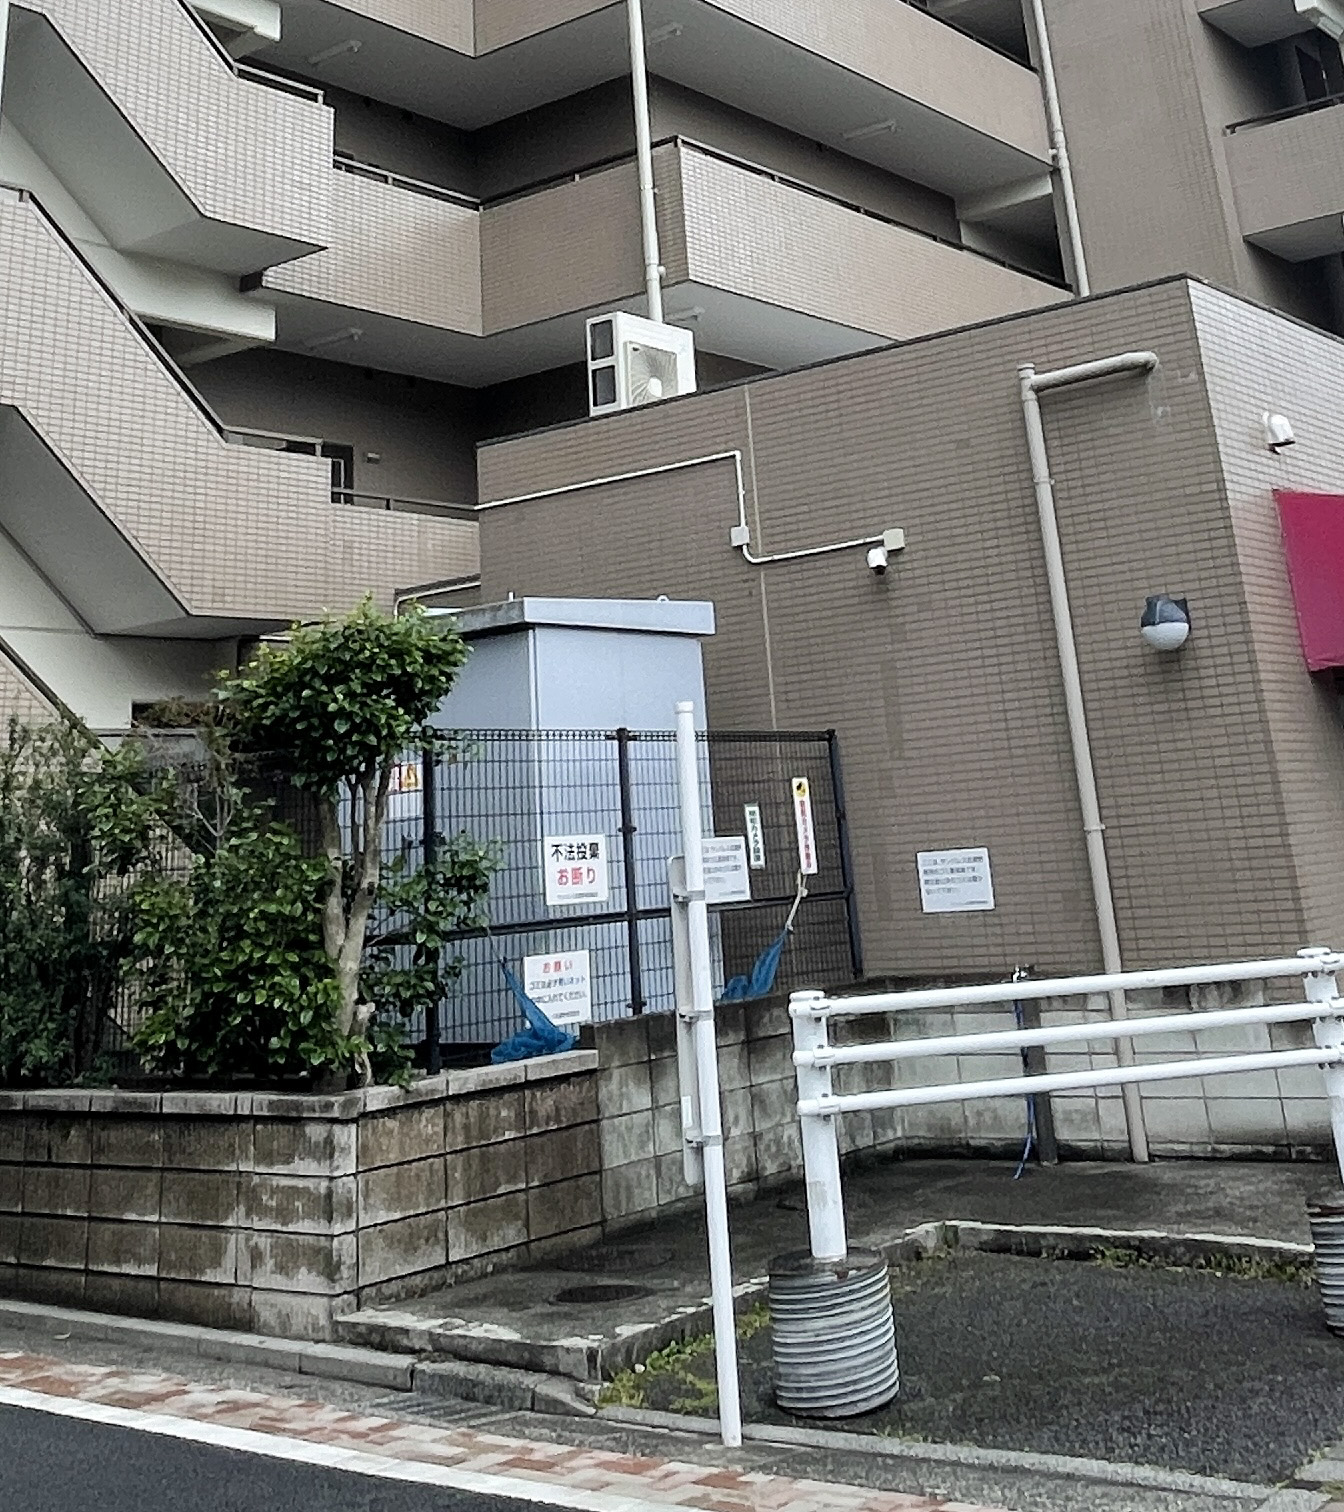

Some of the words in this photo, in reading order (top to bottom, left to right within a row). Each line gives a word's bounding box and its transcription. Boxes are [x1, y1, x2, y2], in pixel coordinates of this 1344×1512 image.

[551, 842, 599, 862] 不法投棄
[557, 866, 596, 886] お断り
